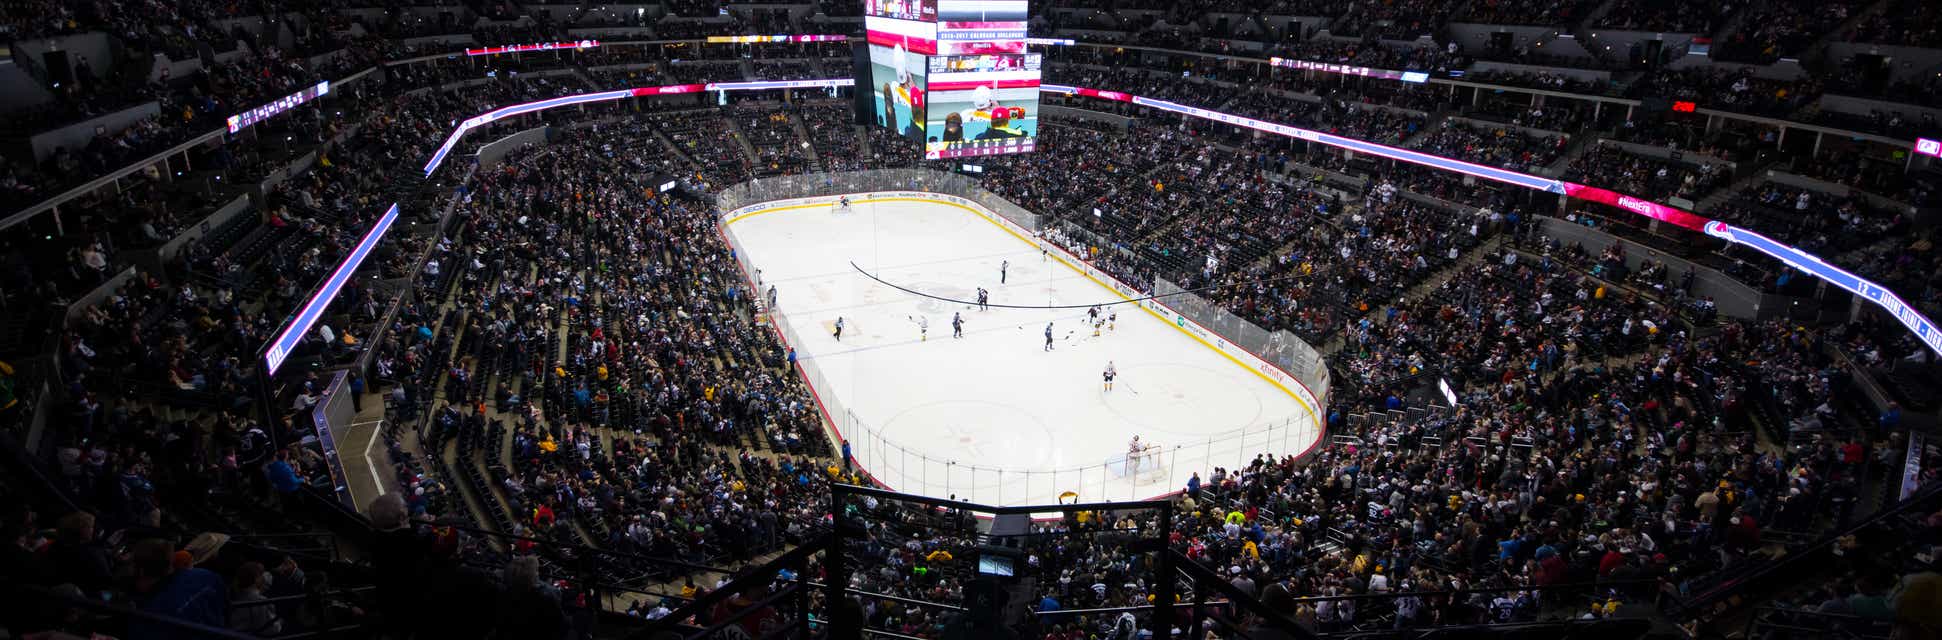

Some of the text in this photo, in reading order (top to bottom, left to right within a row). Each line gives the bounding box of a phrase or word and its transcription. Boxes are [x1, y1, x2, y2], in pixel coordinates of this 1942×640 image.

[1617, 196, 1651, 213] #NextEra
[1857, 281, 1869, 294] 12
[1926, 327, 1942, 352] RIGH
[1260, 363, 1284, 383] xfinity
